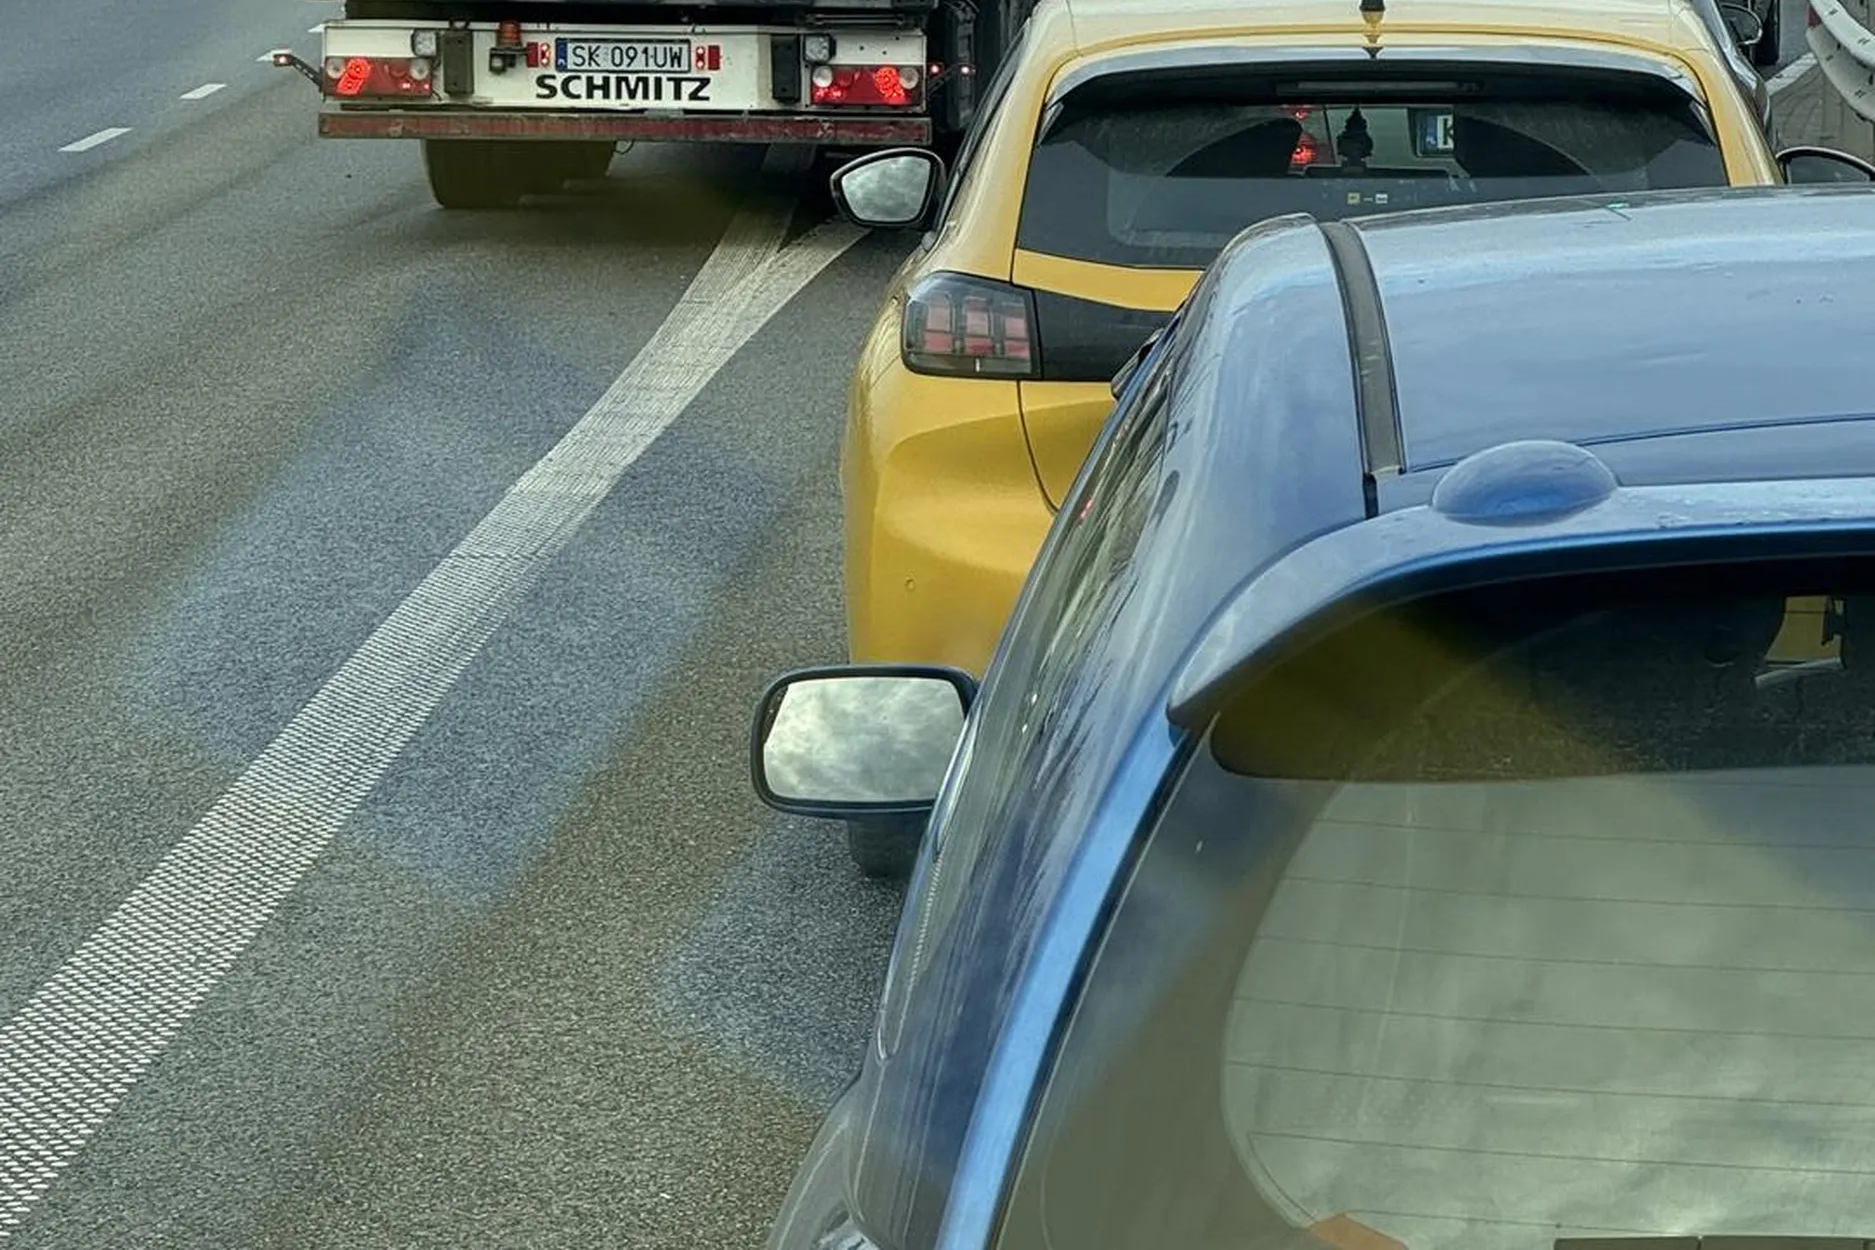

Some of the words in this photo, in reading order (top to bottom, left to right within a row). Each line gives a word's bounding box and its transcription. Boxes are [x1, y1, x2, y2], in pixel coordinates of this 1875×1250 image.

[572, 45, 602, 68] SK
[611, 45, 683, 69] 091UW
[535, 73, 712, 102] SCHMITZ
